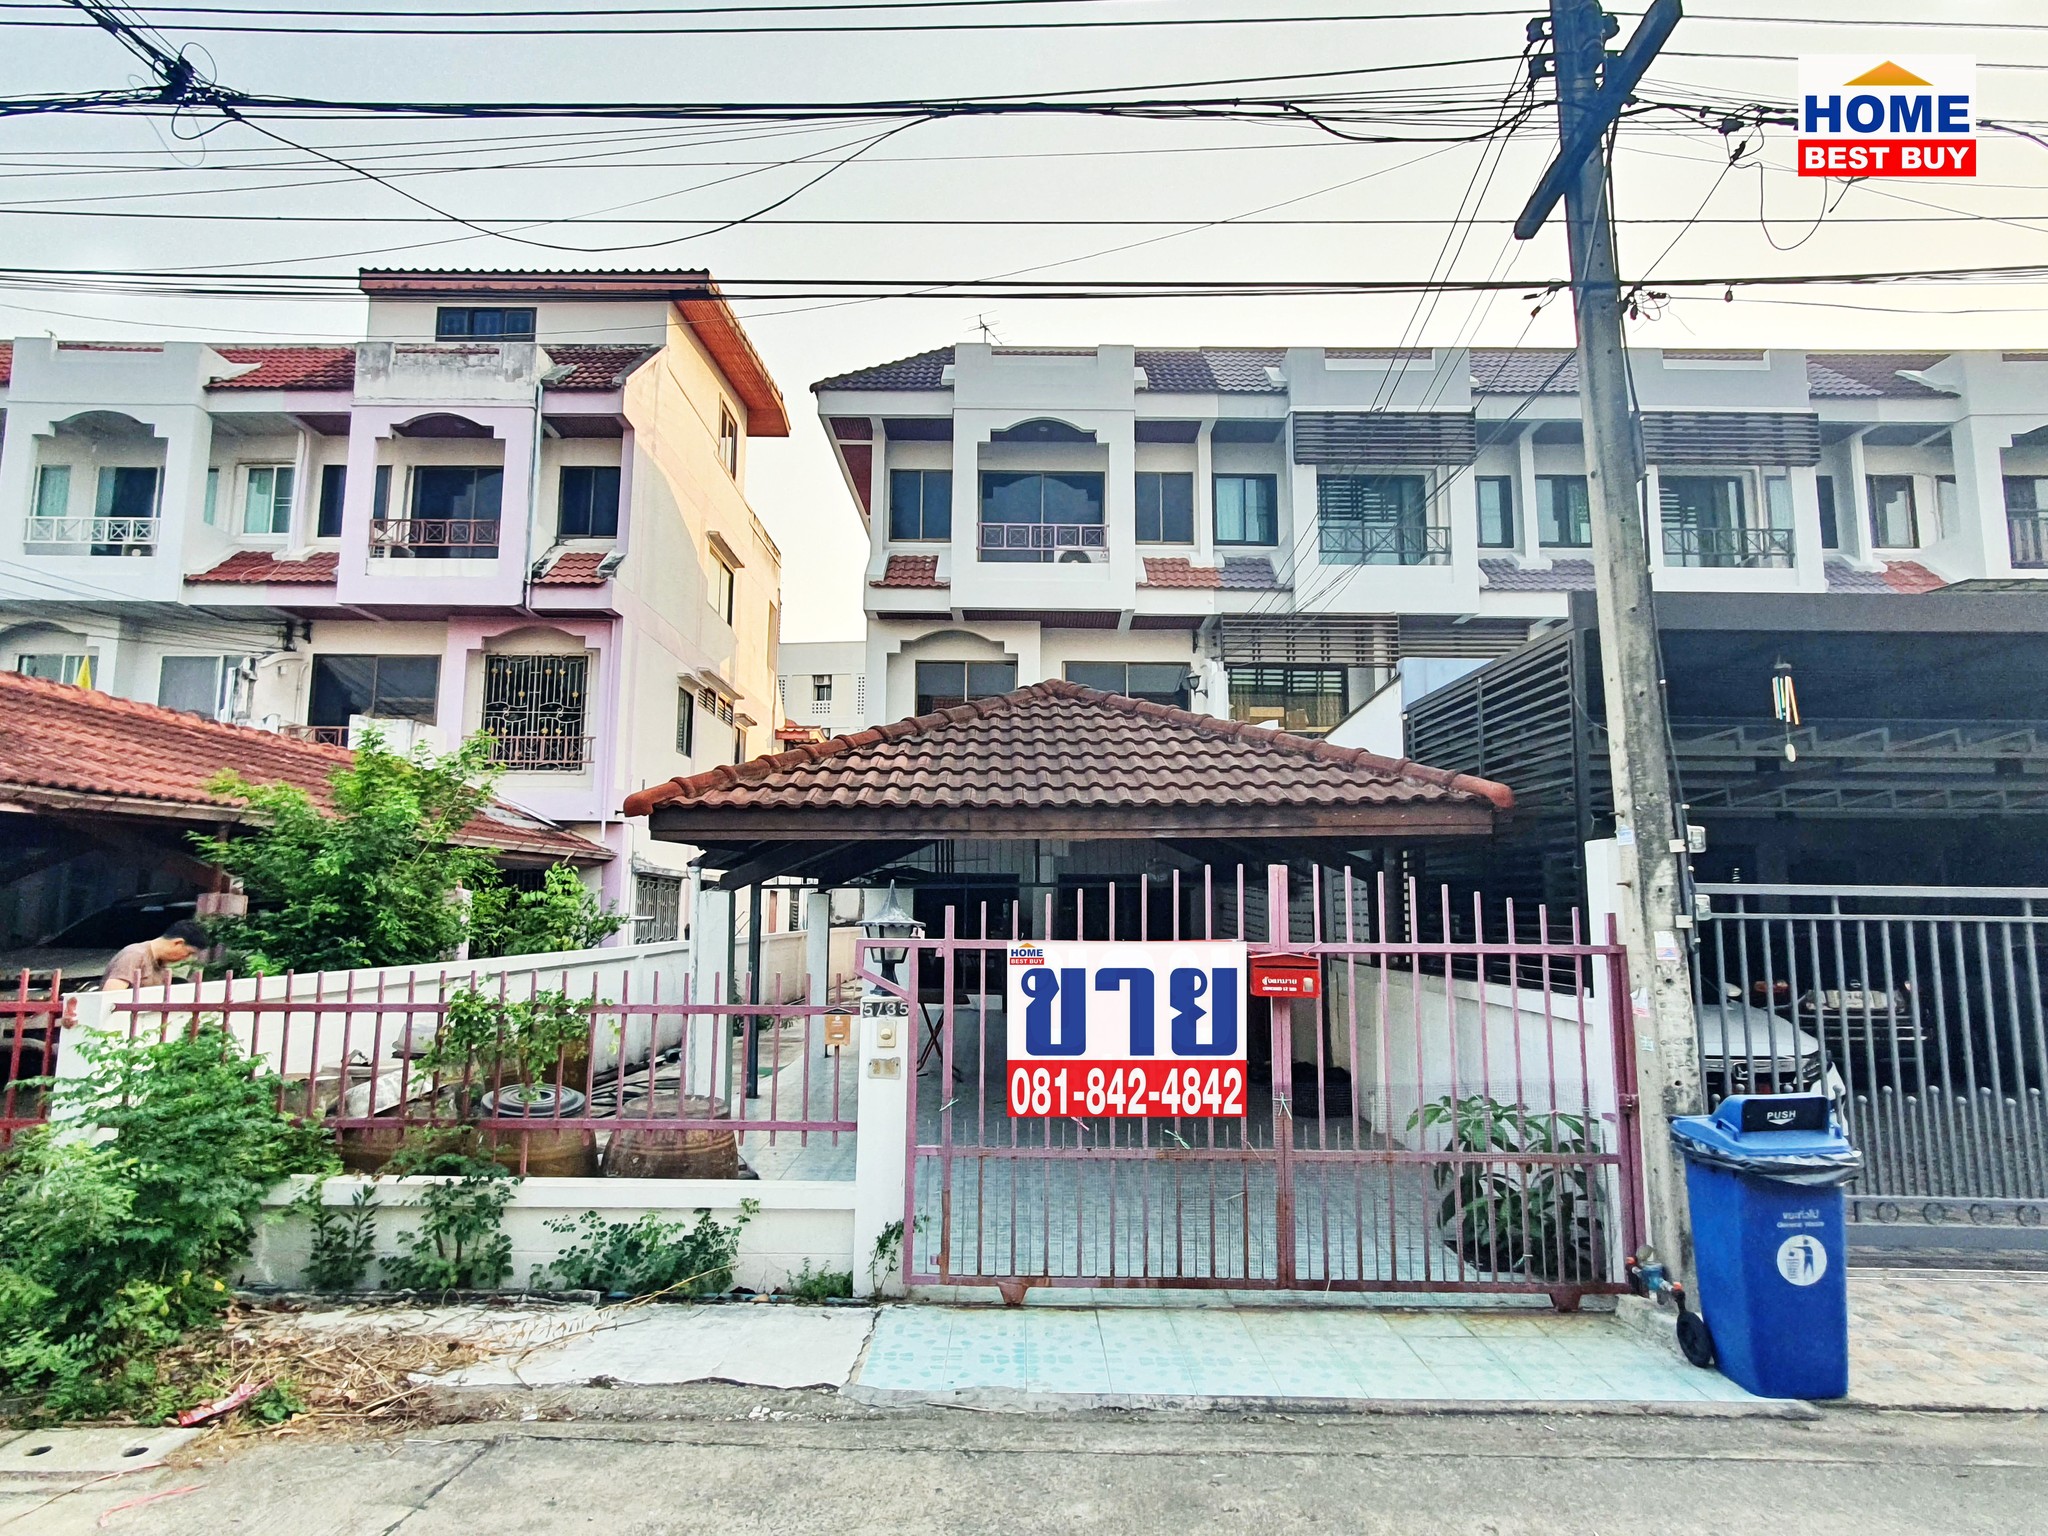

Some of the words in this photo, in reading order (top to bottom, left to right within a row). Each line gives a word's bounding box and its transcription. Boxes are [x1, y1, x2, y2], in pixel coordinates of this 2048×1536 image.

[1010, 948, 1043, 957] HOME
[1020, 967, 1238, 1057] ขาย
[1010, 1067, 1243, 1115] 081-842-4842
[1766, 1110, 1796, 1120] PUSH
